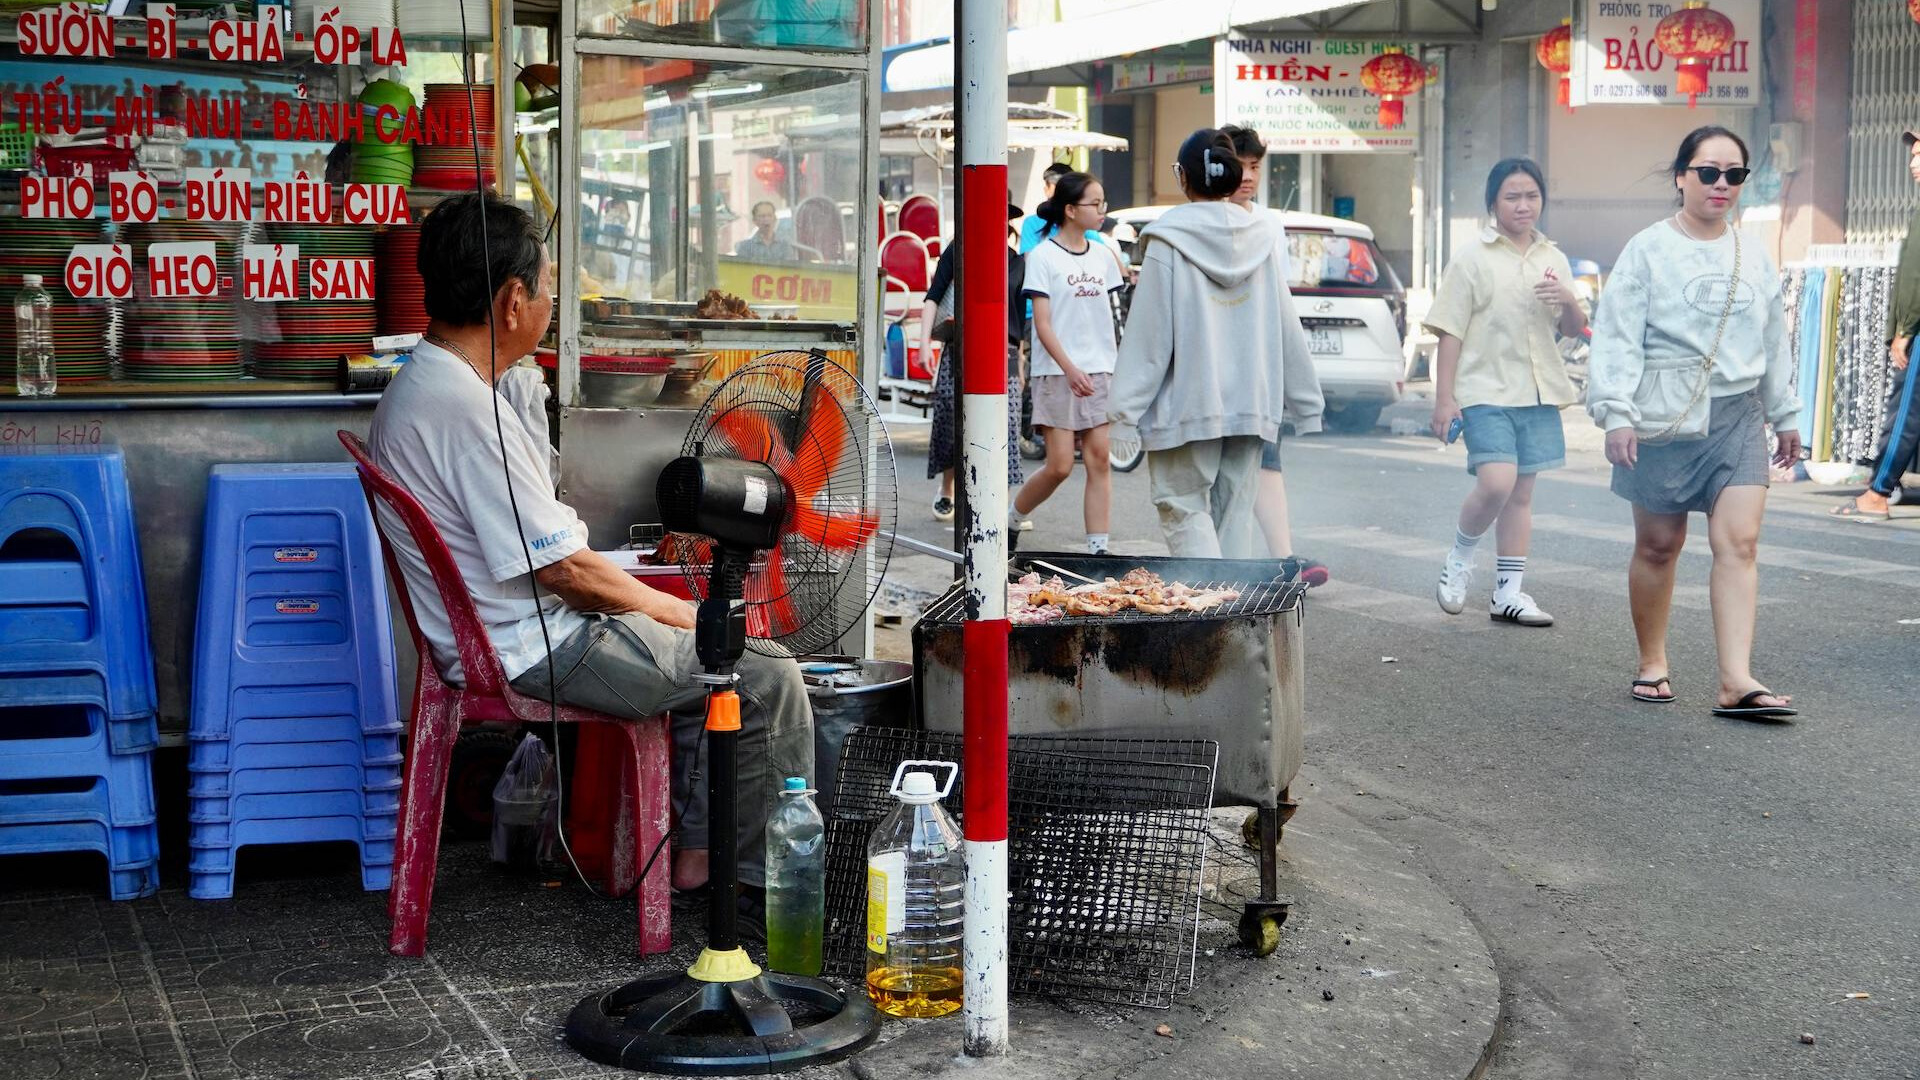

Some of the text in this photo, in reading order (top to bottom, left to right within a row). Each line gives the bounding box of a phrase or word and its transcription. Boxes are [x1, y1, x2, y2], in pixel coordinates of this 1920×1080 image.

[18, 2, 407, 67] SƯỜN BÌ CHẢ ỐP LA
[1325, 41, 1367, 55] GUEST
[1604, 26, 1664, 71] BẢO
[14, 75, 82, 135] TIẾU
[115, 84, 153, 137] MÌ
[186, 98, 241, 139] NUI
[375, 104, 469, 145] CANH
[1734, 87, 1748, 99] 999
[110, 171, 158, 222] BÒ
[186, 168, 251, 221] BÚN
[264, 171, 332, 223] RIÊU
[344, 183, 412, 224] CUA
[66, 244, 375, 299] GIÒ HEO HẢI SAN
[752, 274, 832, 303] CƠM
[0, 419, 103, 444] ÔM KHÔ
